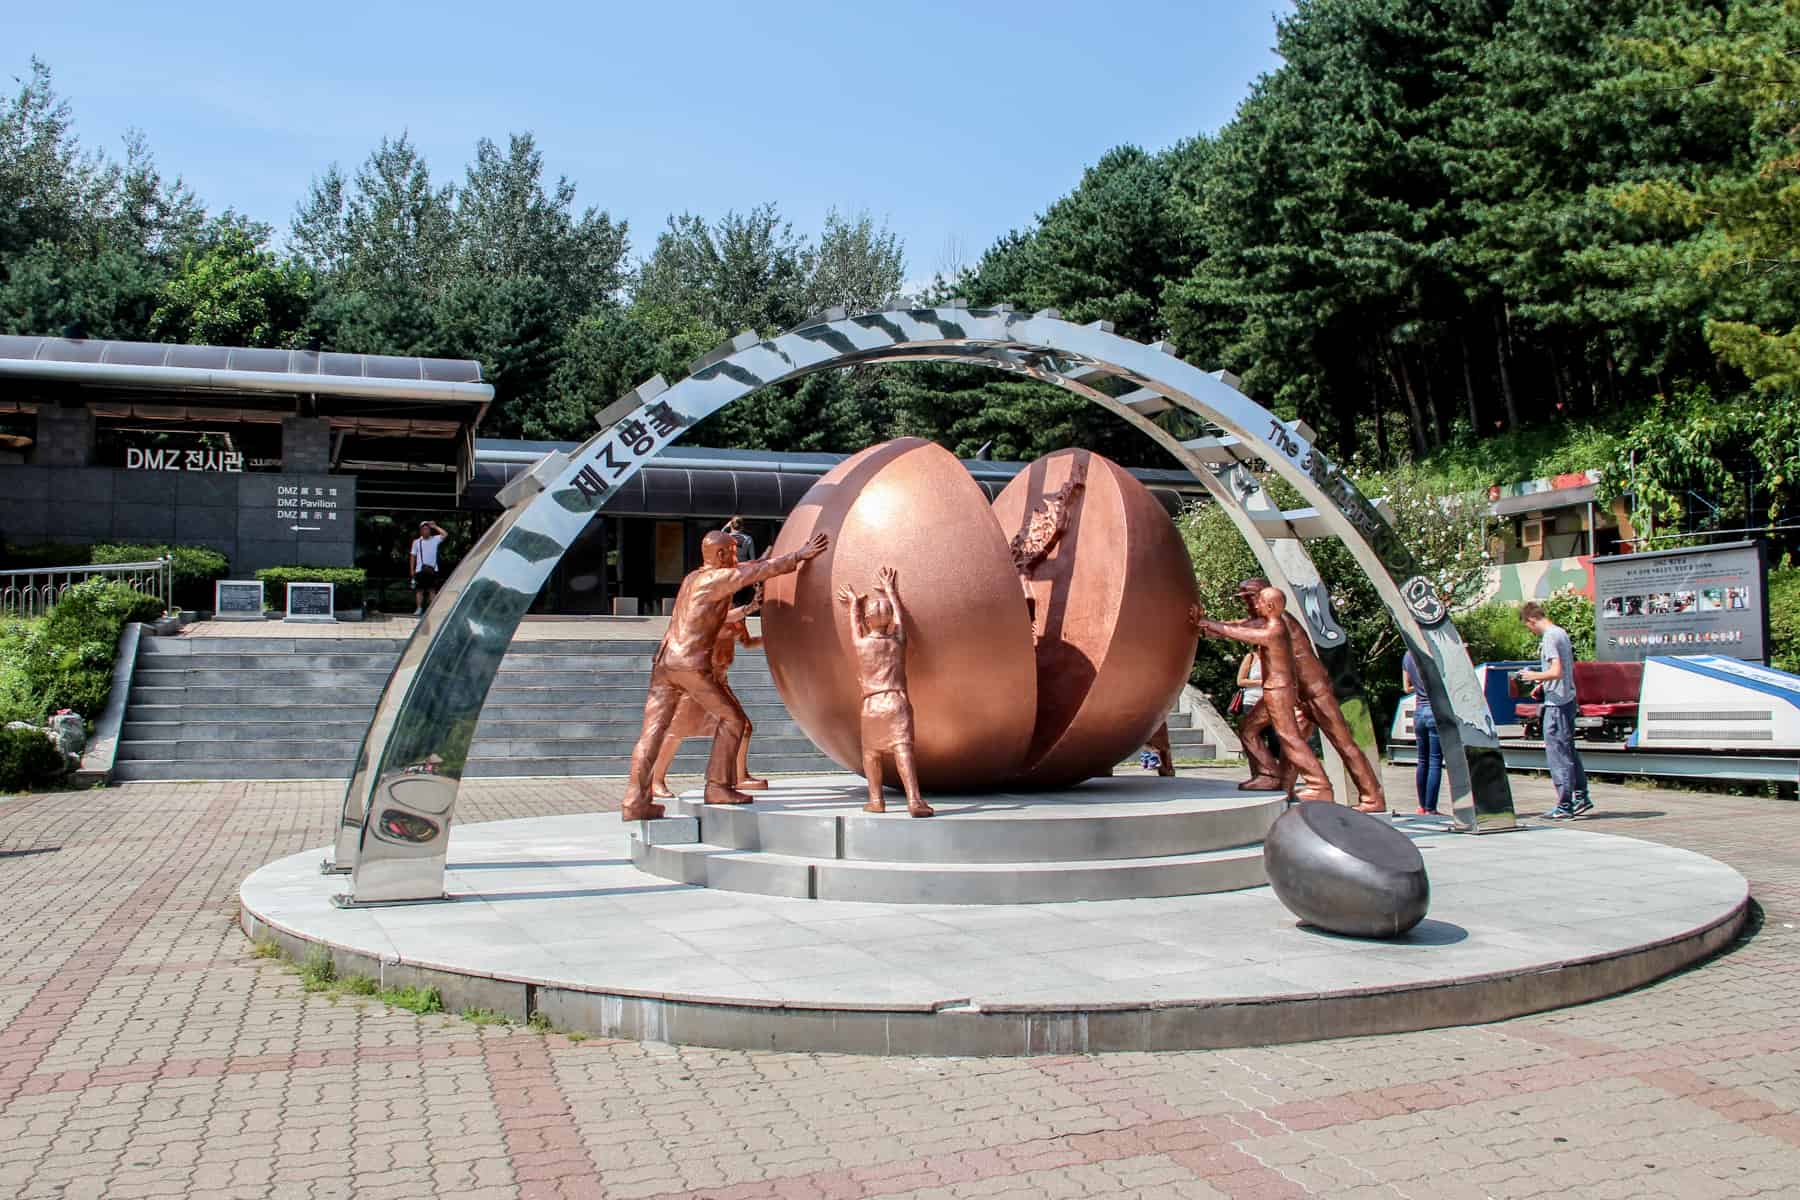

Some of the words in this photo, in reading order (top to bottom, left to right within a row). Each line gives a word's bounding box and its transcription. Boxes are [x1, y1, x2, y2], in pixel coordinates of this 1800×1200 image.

[1268, 419, 1299, 458] The
[127, 448, 181, 470] DMZ
[184, 450, 244, 472] 전시관
[277, 486, 298, 495] DMZ
[277, 498, 298, 507] DMZ
[300, 499, 337, 508] Pavilion
[277, 510, 298, 519] DMZ
